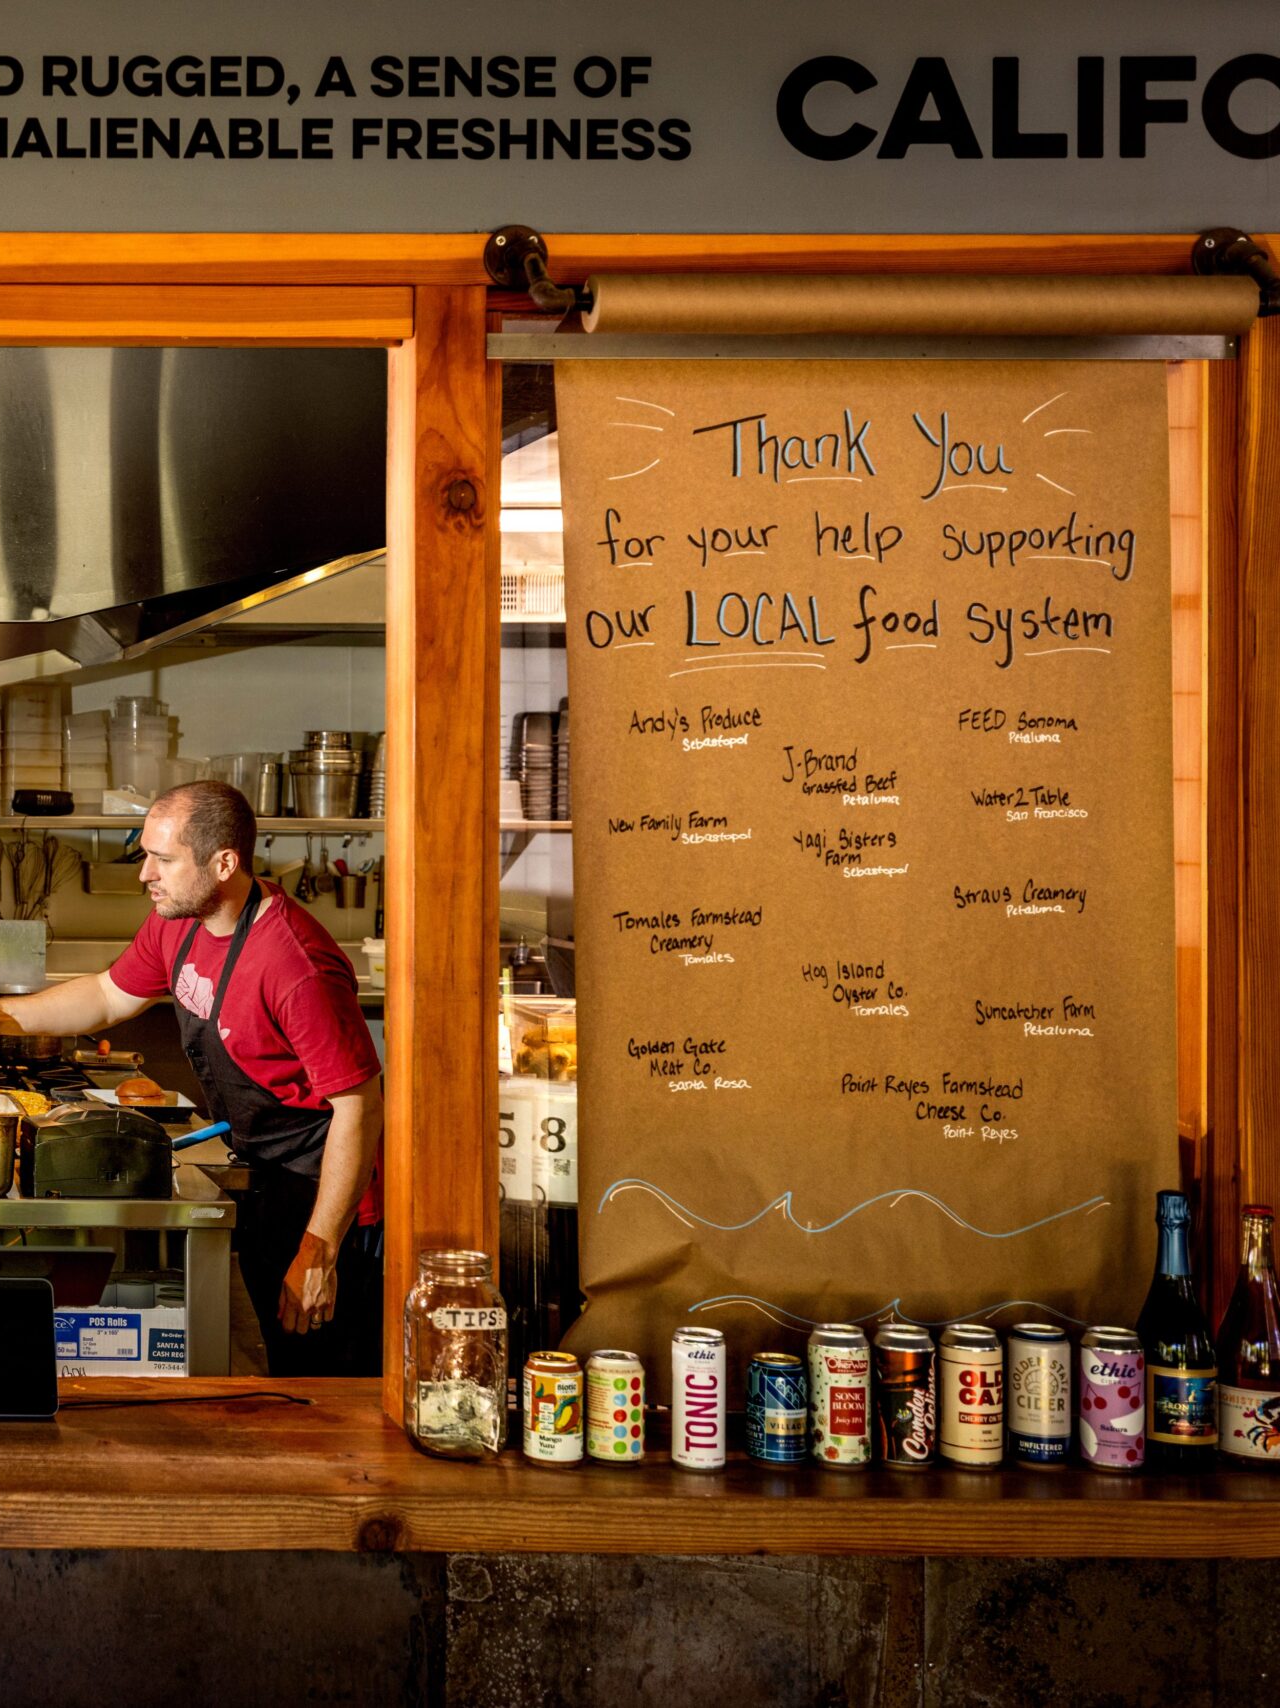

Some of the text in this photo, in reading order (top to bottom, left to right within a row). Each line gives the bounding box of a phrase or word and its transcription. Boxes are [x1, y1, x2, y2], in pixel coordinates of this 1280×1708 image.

[41, 55, 302, 105] RUGGED,
[314, 56, 358, 98] A
[370, 56, 557, 98] SENSE
[573, 56, 653, 98] OF
[776, 54, 1280, 161] CALIFO
[352, 117, 692, 160] FRESHNESS
[693, 408, 1013, 501] Thank You
[598, 508, 1137, 581] for your help supporting
[586, 585, 1113, 669] our LOCAL food system
[629, 705, 763, 742] Andy's Produce
[958, 708, 1079, 732] FEED Sonoma
[682, 733, 749, 751] Sebastopol
[1008, 731, 1061, 744] Petaluma
[802, 770, 897, 796] Grassfed Beef
[842, 793, 900, 806] Petaluma
[1006, 807, 1088, 822] San Francisco
[608, 810, 728, 841] New Family Farm
[681, 828, 753, 845] Sebastopol
[838, 828, 897, 850] Sisters
[825, 849, 862, 866] Farm
[843, 863, 910, 878] Sebastopol
[953, 878, 1087, 914] Straus Creamery
[613, 905, 763, 932] Tomales Farmstead
[1006, 904, 1065, 918] Petaluma
[650, 933, 714, 955] Creamery
[678, 951, 735, 967] Tomales
[801, 959, 885, 990] Hog Island
[832, 981, 909, 1009] Oyster Co.
[849, 1002, 910, 1018] Tomales
[975, 995, 1096, 1026] Suncatcher Farm
[1023, 1021, 1095, 1038] Petaluma
[627, 1036, 727, 1059] Golden Gate
[650, 1057, 717, 1078] Meat Co.
[713, 1076, 752, 1090] Rosa
[841, 1072, 1024, 1101] Point Reyes Farmstead
[915, 1101, 1007, 1123] Cheese Co.
[539, 1116, 567, 1152] 8
[942, 1125, 1019, 1144] Point Reyes
[89, 1317, 127, 1327] POS Rolls
[446, 1310, 498, 1328] TIPS
[687, 1350, 716, 1360] ethic
[1090, 1362, 1137, 1378] ethic
[832, 1401, 865, 1410] BLOOM
[834, 1392, 863, 1401] SONIC
[1017, 1395, 1065, 1411] CIDER
[685, 1374, 718, 1452] TONIC
[1020, 1440, 1063, 1452] UNFILTERED
